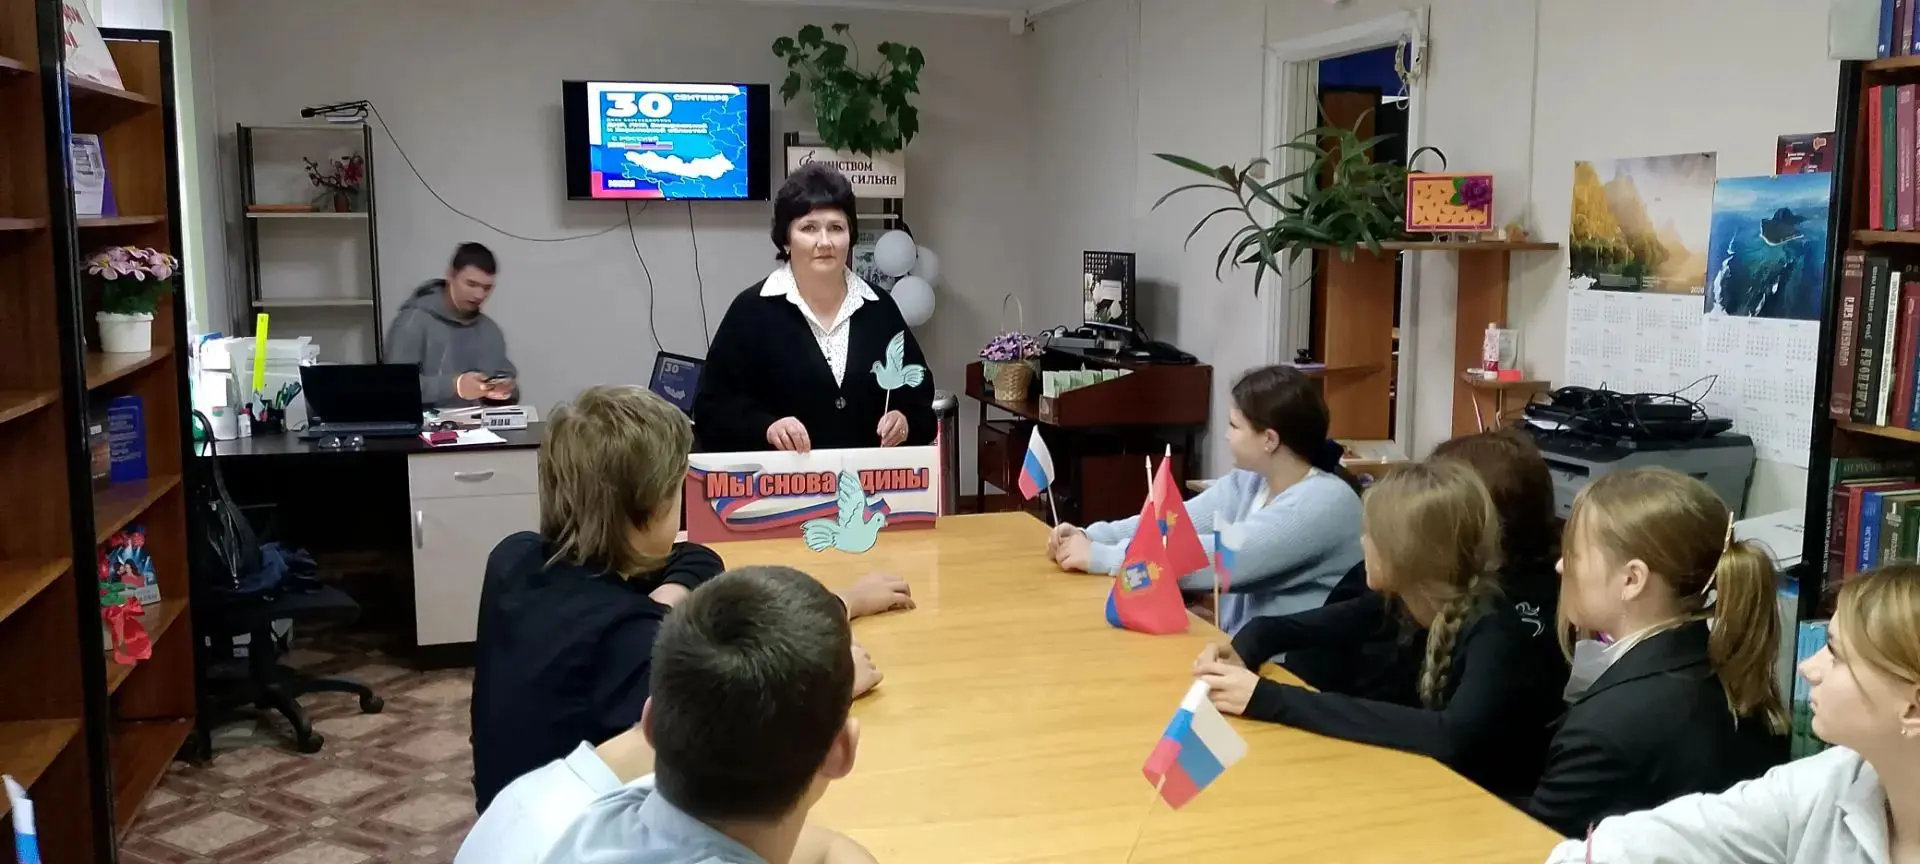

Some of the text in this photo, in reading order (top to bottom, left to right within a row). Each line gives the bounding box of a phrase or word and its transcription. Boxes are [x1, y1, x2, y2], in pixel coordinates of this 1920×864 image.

[606, 92, 673, 118] 30
[851, 174, 897, 185] СИЛЬНА
[664, 362, 680, 374] 30
[706, 467, 930, 499] Мы снова дины
